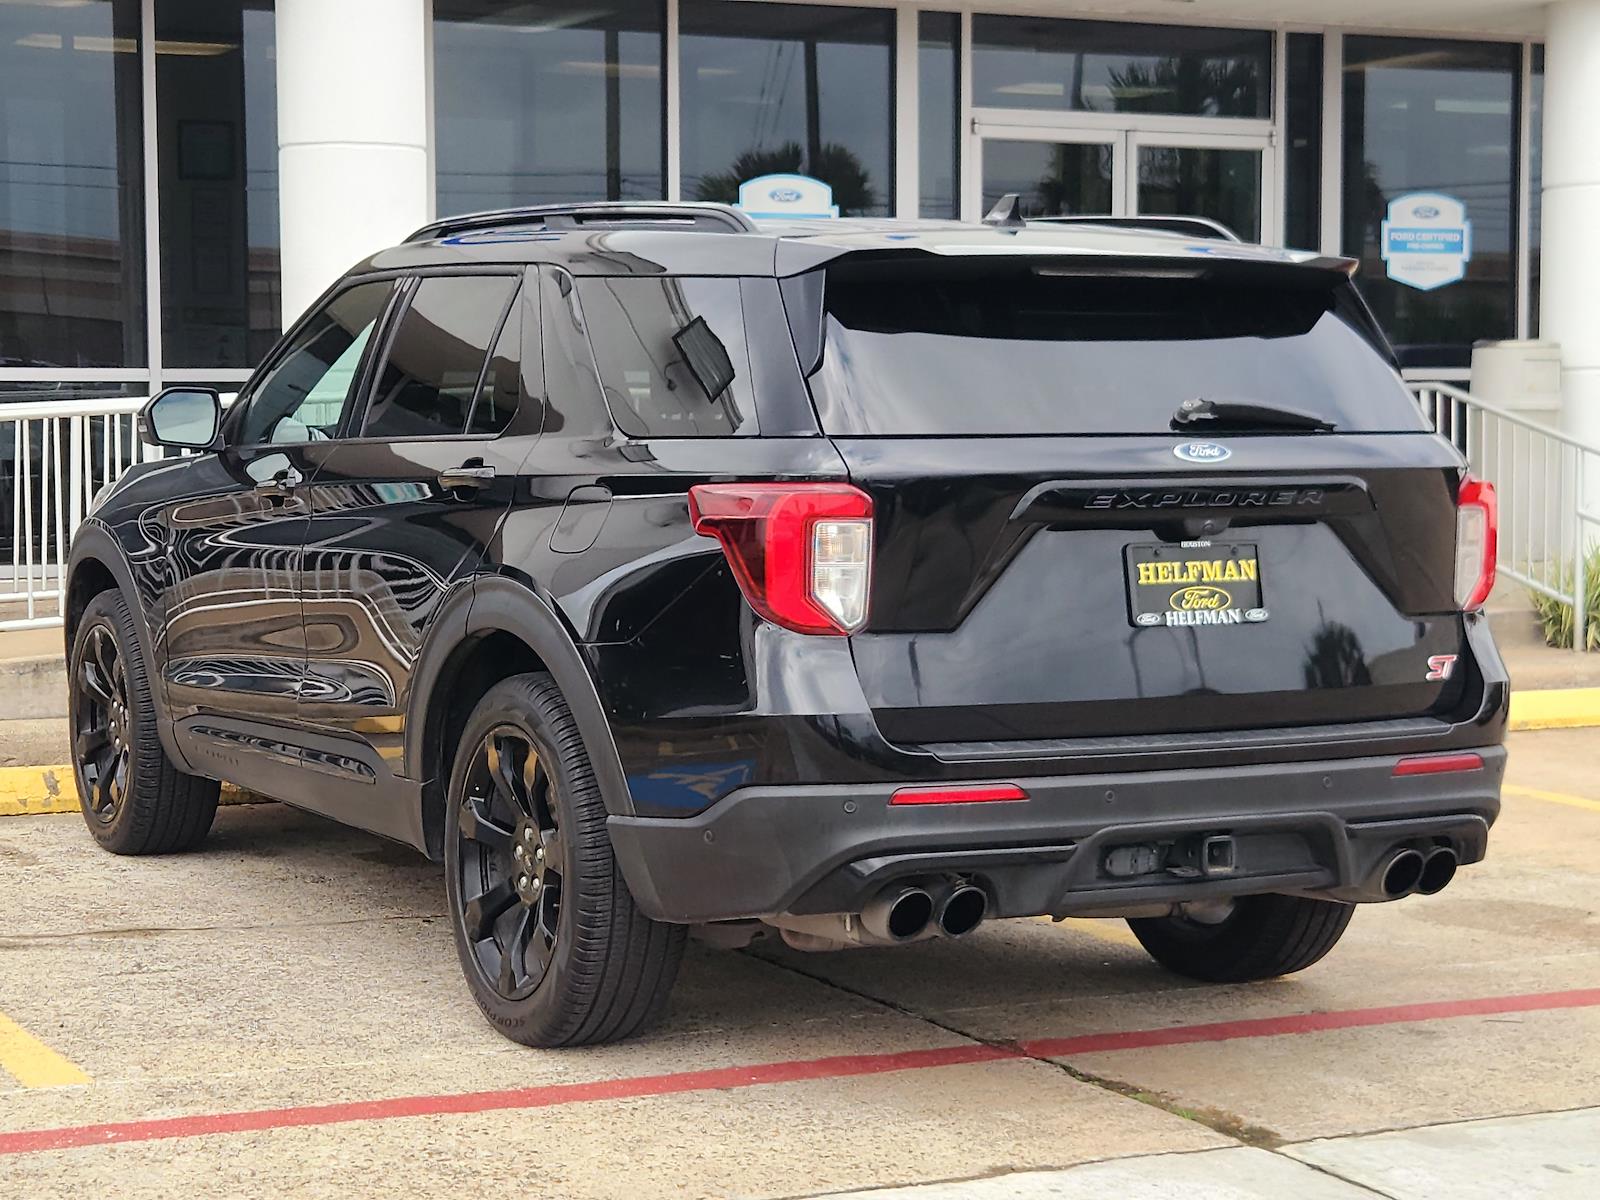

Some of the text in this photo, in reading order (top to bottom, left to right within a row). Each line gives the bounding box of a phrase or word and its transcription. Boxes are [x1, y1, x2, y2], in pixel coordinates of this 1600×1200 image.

[1391, 232, 1460, 242] FORD CERTIFIED
[1187, 443, 1221, 458] Ford
[1083, 489, 1324, 509] EXPLORER
[1181, 540, 1211, 548] HOUSTON
[1136, 558, 1257, 585] HELFMAN
[1180, 589, 1221, 609] Ford
[1165, 607, 1242, 627] HELFMAN
[1425, 654, 1459, 681] ST
